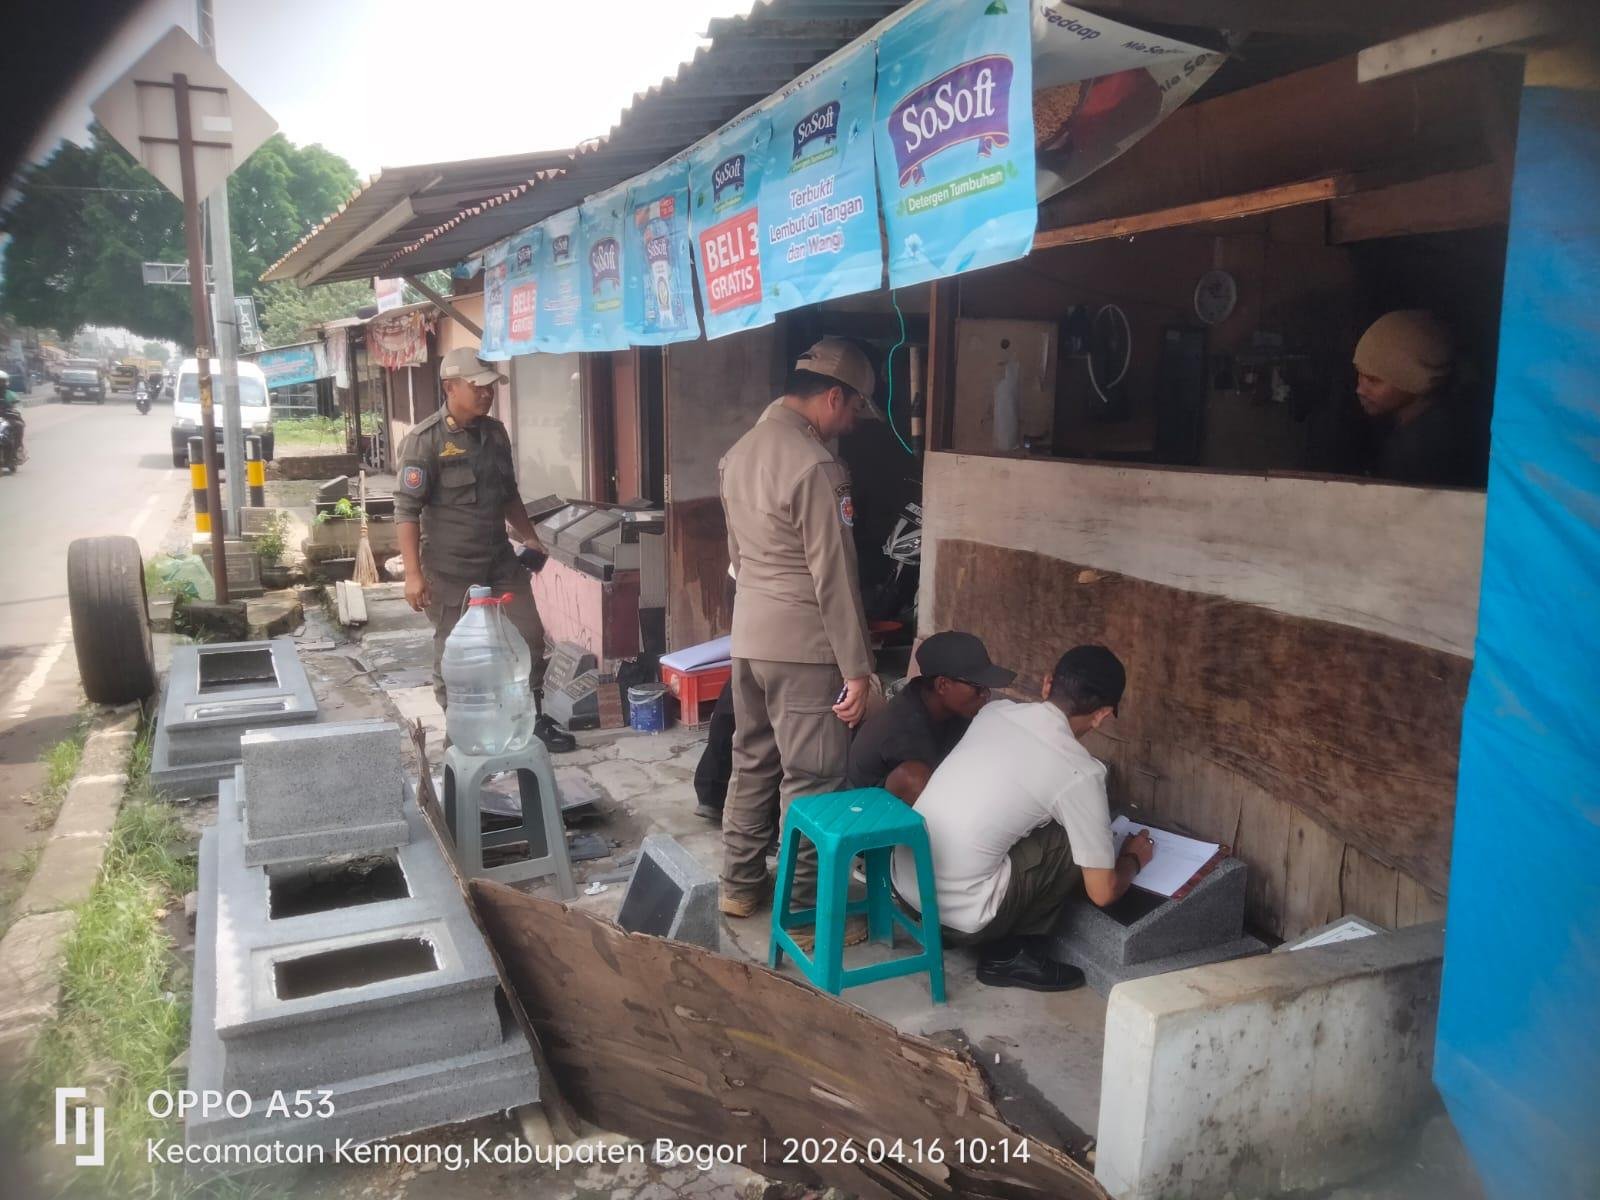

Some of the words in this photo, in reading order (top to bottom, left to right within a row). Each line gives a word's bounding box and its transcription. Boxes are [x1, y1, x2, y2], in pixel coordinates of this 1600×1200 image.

[798, 106, 834, 143] SoSoft
[902, 68, 996, 153] SoSoft
[715, 158, 741, 190] SoSoft
[789, 176, 835, 209] Terbukti
[908, 188, 949, 212] Detergen
[949, 170, 1003, 197] Tumbuhan
[769, 219, 808, 244] Lembut
[806, 210, 819, 231] di
[819, 197, 864, 227] Tangan
[705, 227, 746, 273] BELI
[747, 222, 759, 257] 3
[787, 242, 806, 263] dan
[807, 226, 844, 255] Wangi
[710, 268, 754, 301] GRATIS
